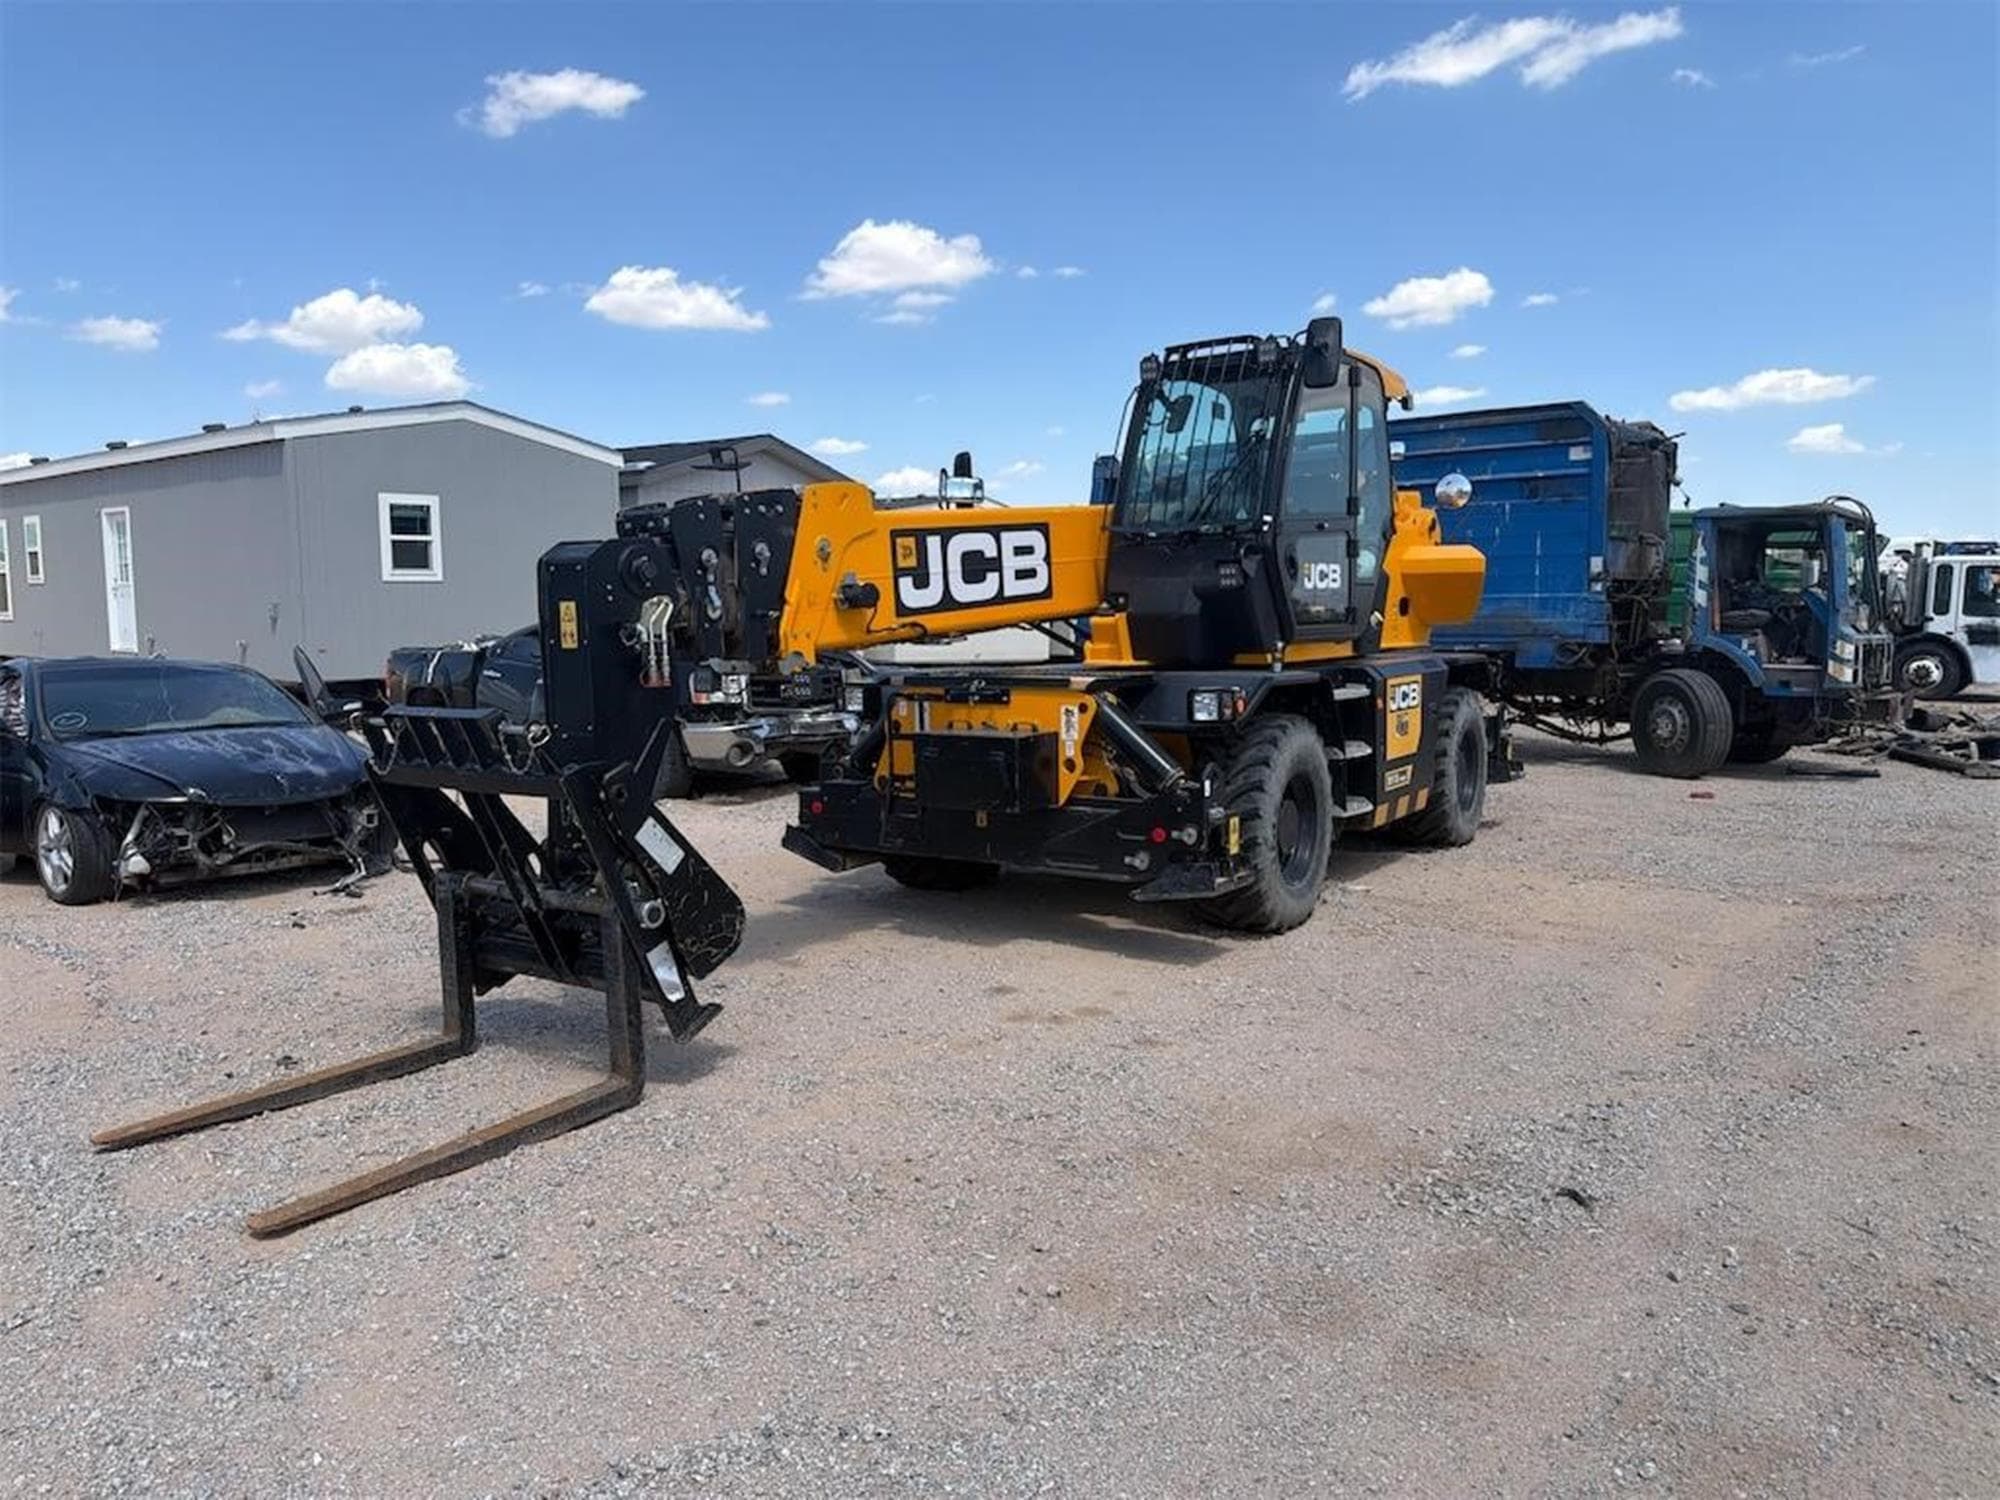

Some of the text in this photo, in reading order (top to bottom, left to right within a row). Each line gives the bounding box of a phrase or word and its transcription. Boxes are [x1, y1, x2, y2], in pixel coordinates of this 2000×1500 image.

[898, 529, 1049, 609] JCB
[1304, 563, 1342, 589] JCB
[1390, 684, 1418, 711] JCB
